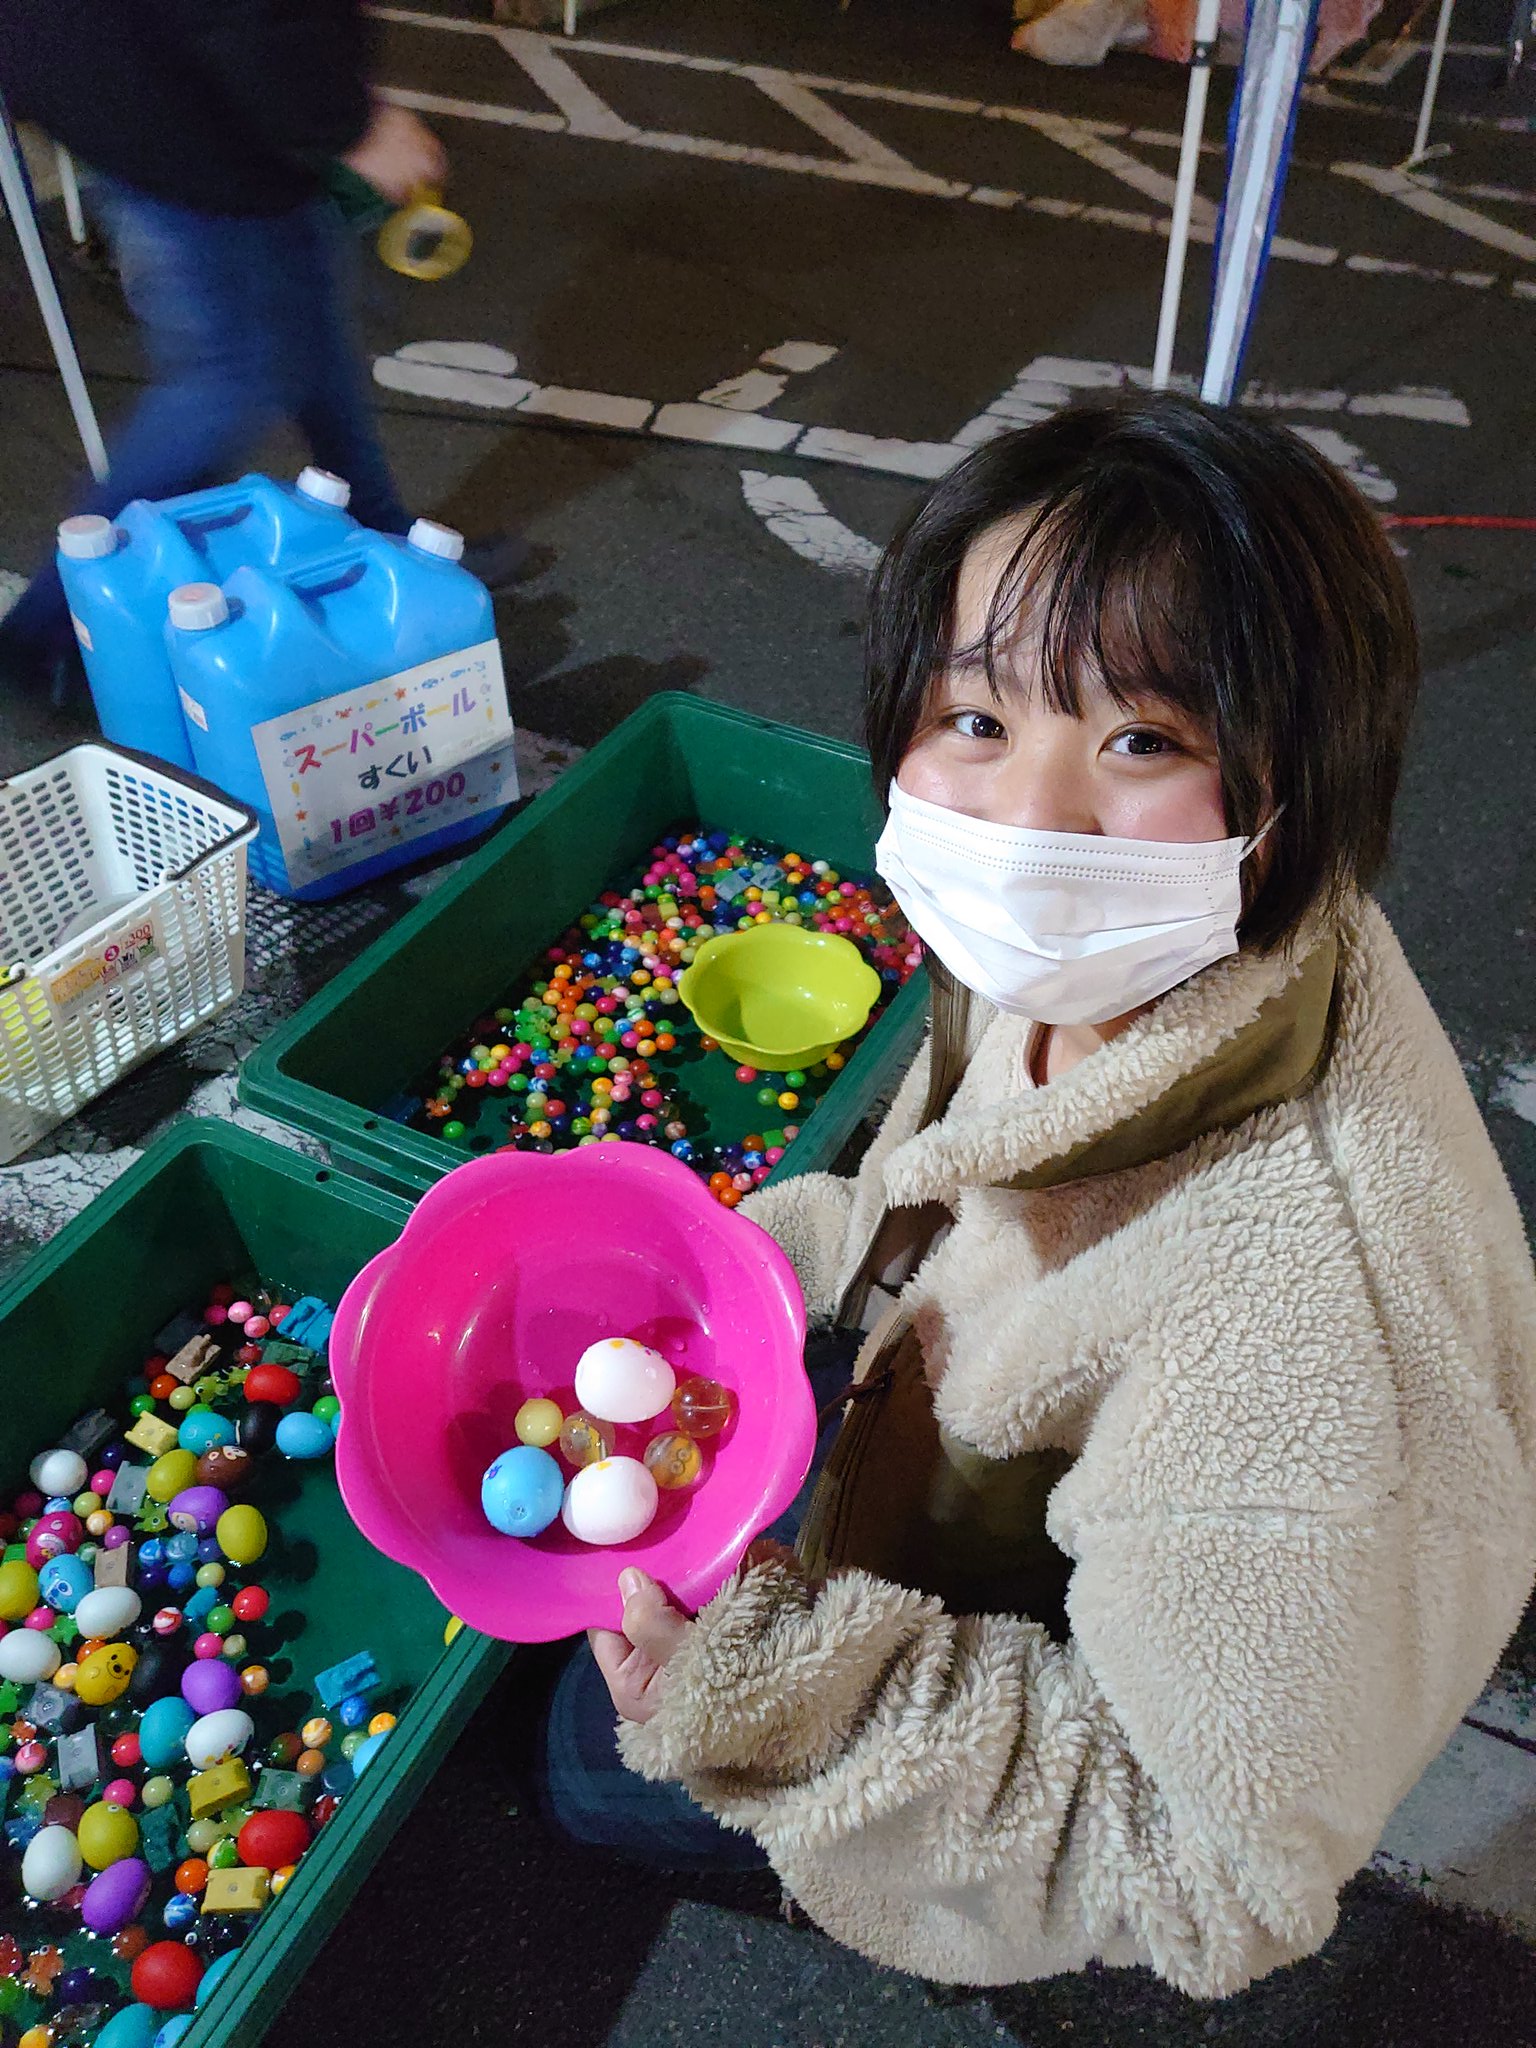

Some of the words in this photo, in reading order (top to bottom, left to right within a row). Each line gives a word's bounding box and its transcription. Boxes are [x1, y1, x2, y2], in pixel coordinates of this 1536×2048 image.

[294, 687, 477, 774] スーパーボール
[358, 745, 432, 790] すくい
